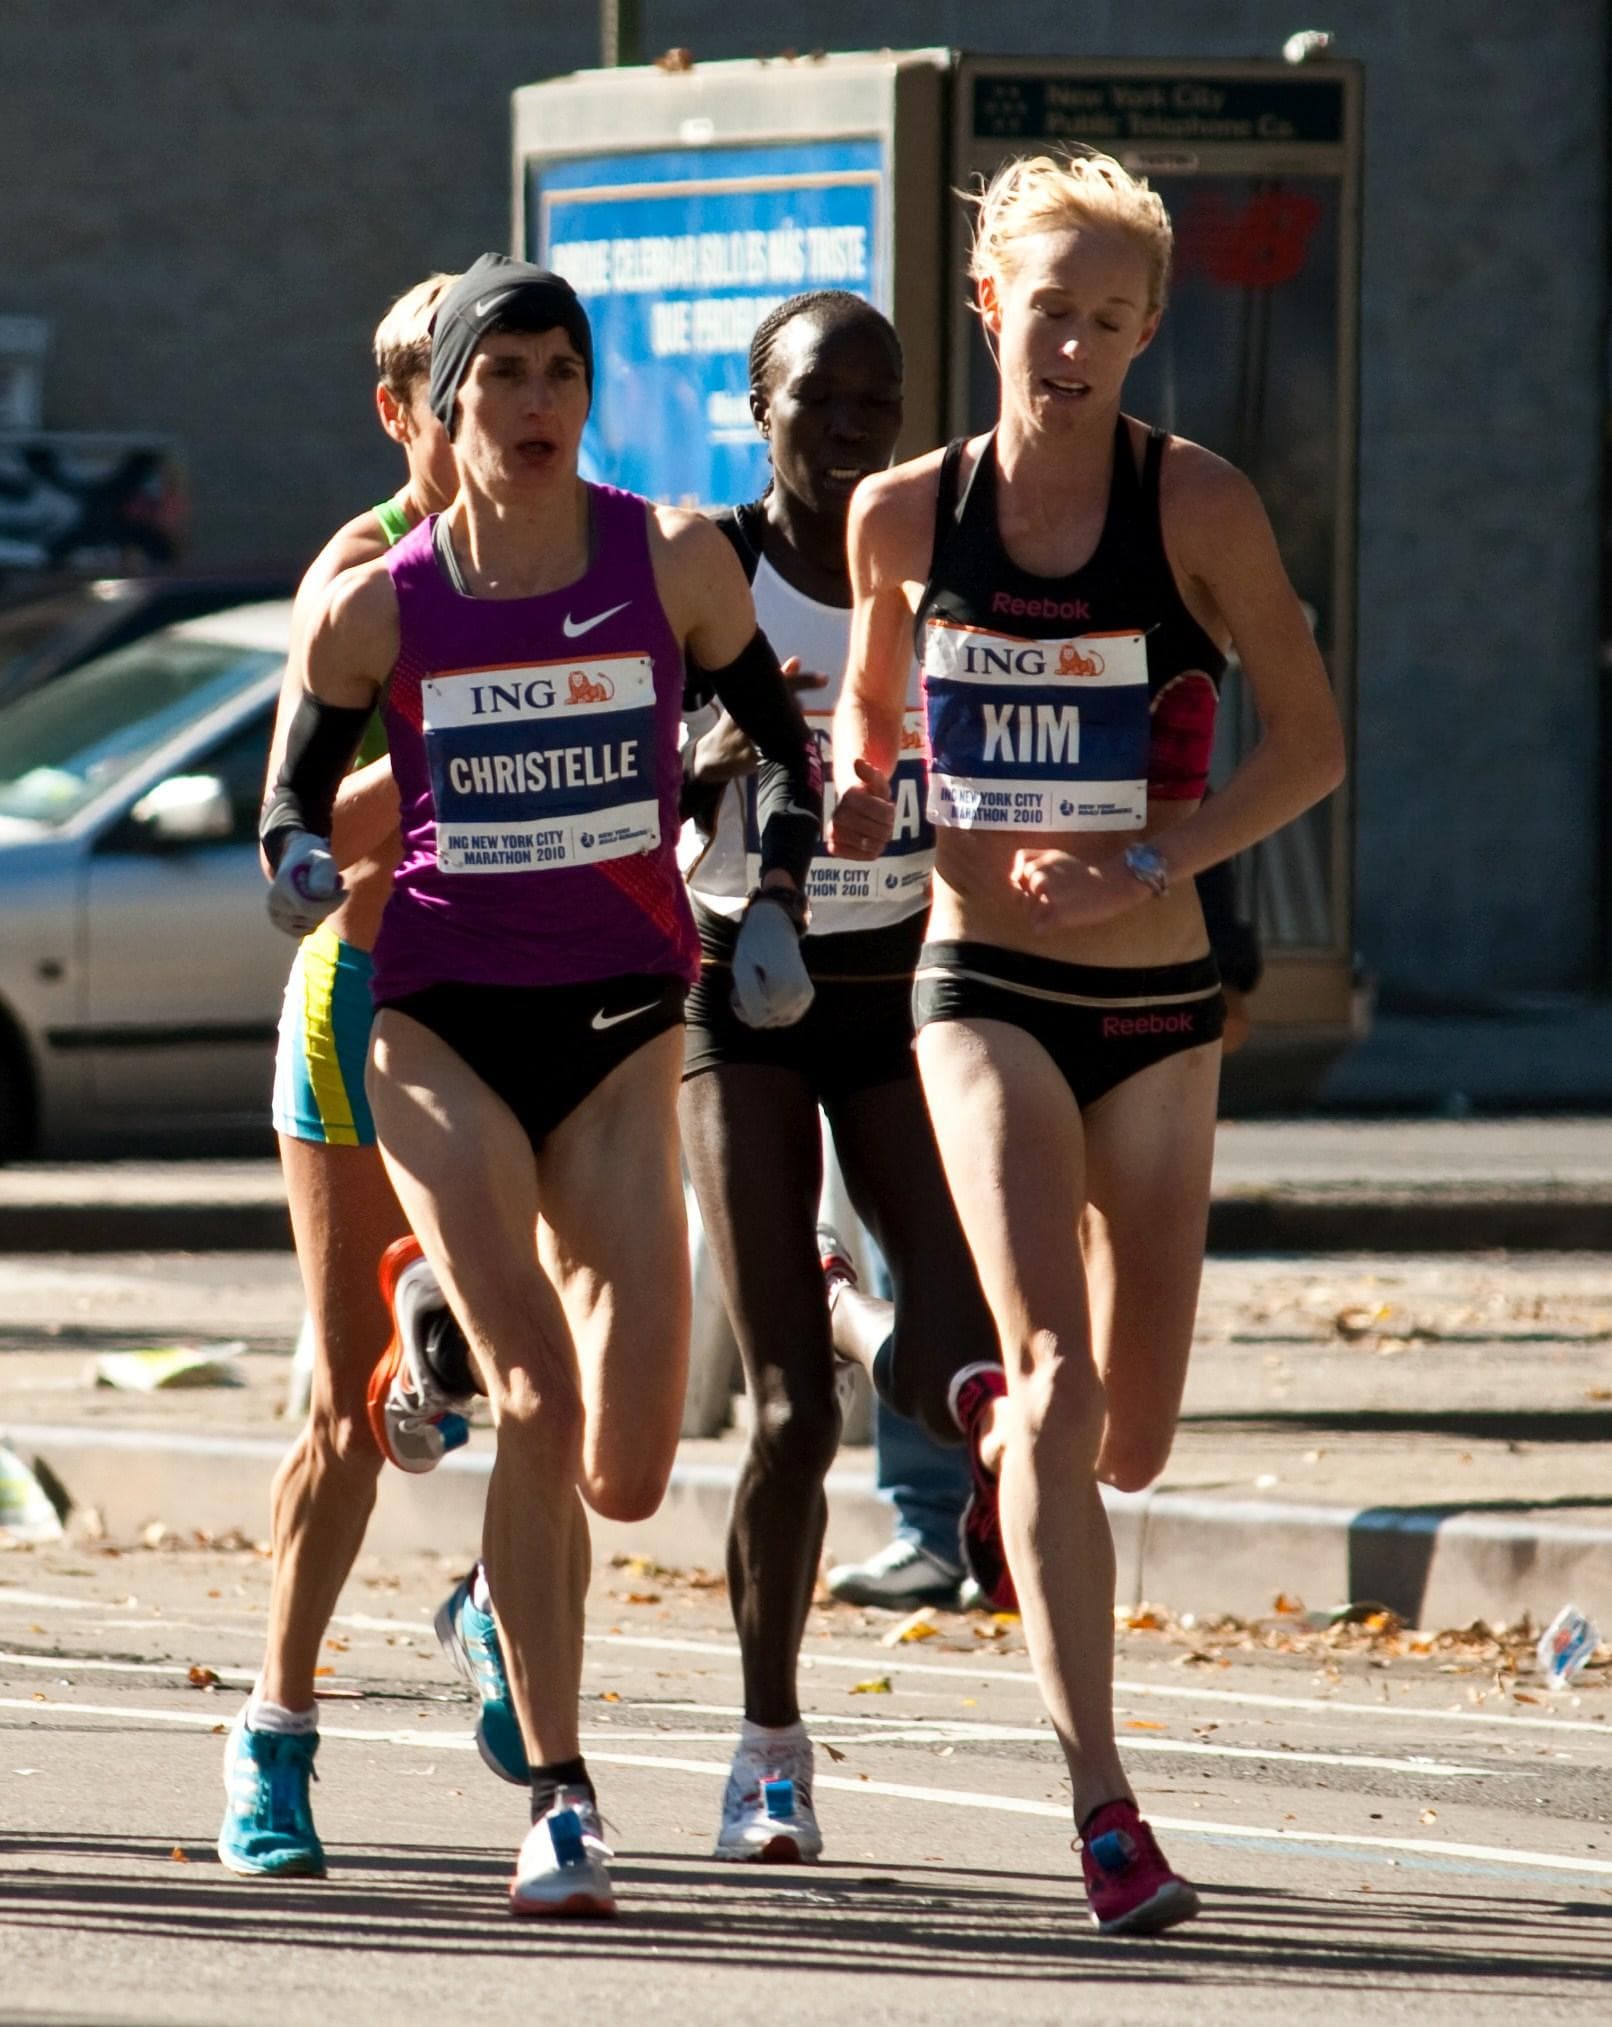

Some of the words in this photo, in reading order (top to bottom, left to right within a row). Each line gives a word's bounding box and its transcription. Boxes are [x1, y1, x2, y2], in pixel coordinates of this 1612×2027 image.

[991, 591, 1091, 620] Reebok
[964, 644, 1047, 677] ING
[470, 679, 557, 715] ING
[982, 703, 1081, 765] KIM
[449, 740, 638, 795] CHRISTELLE
[980, 792, 1013, 807] YORK
[1014, 793, 1044, 808] CITY
[1013, 808, 1044, 824] 2010
[448, 835, 469, 850] ING
[471, 834, 498, 850] NEW
[500, 833, 535, 849] YORK
[536, 830, 565, 847] CITY
[463, 848, 532, 865] MARATHON
[536, 846, 566, 862] 2010
[811, 868, 841, 882] YORK
[843, 869, 871, 882] CITY
[842, 883, 870, 897] 2010
[1103, 1012, 1195, 1038] Reebok
